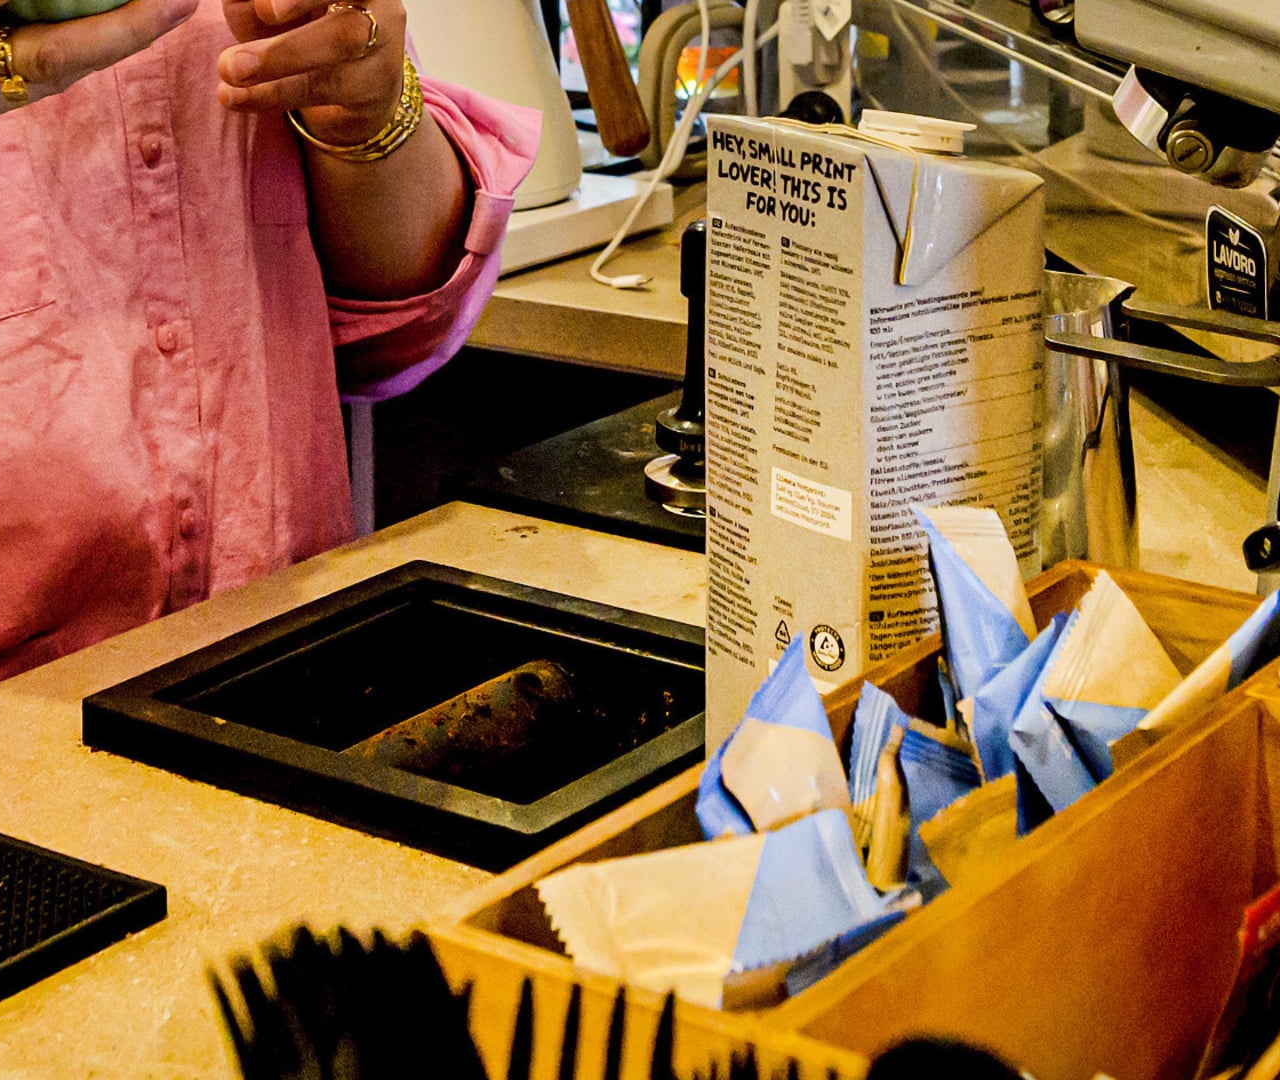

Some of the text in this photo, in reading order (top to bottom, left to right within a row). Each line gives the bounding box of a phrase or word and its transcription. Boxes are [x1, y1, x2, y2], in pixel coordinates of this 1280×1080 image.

[712, 131, 856, 183] HEY, SMALL PRINT
[718, 159, 847, 210] LOVER! THIS IS
[746, 191, 816, 227] FOR YOU:
[1213, 240, 1256, 277] LAVORO
